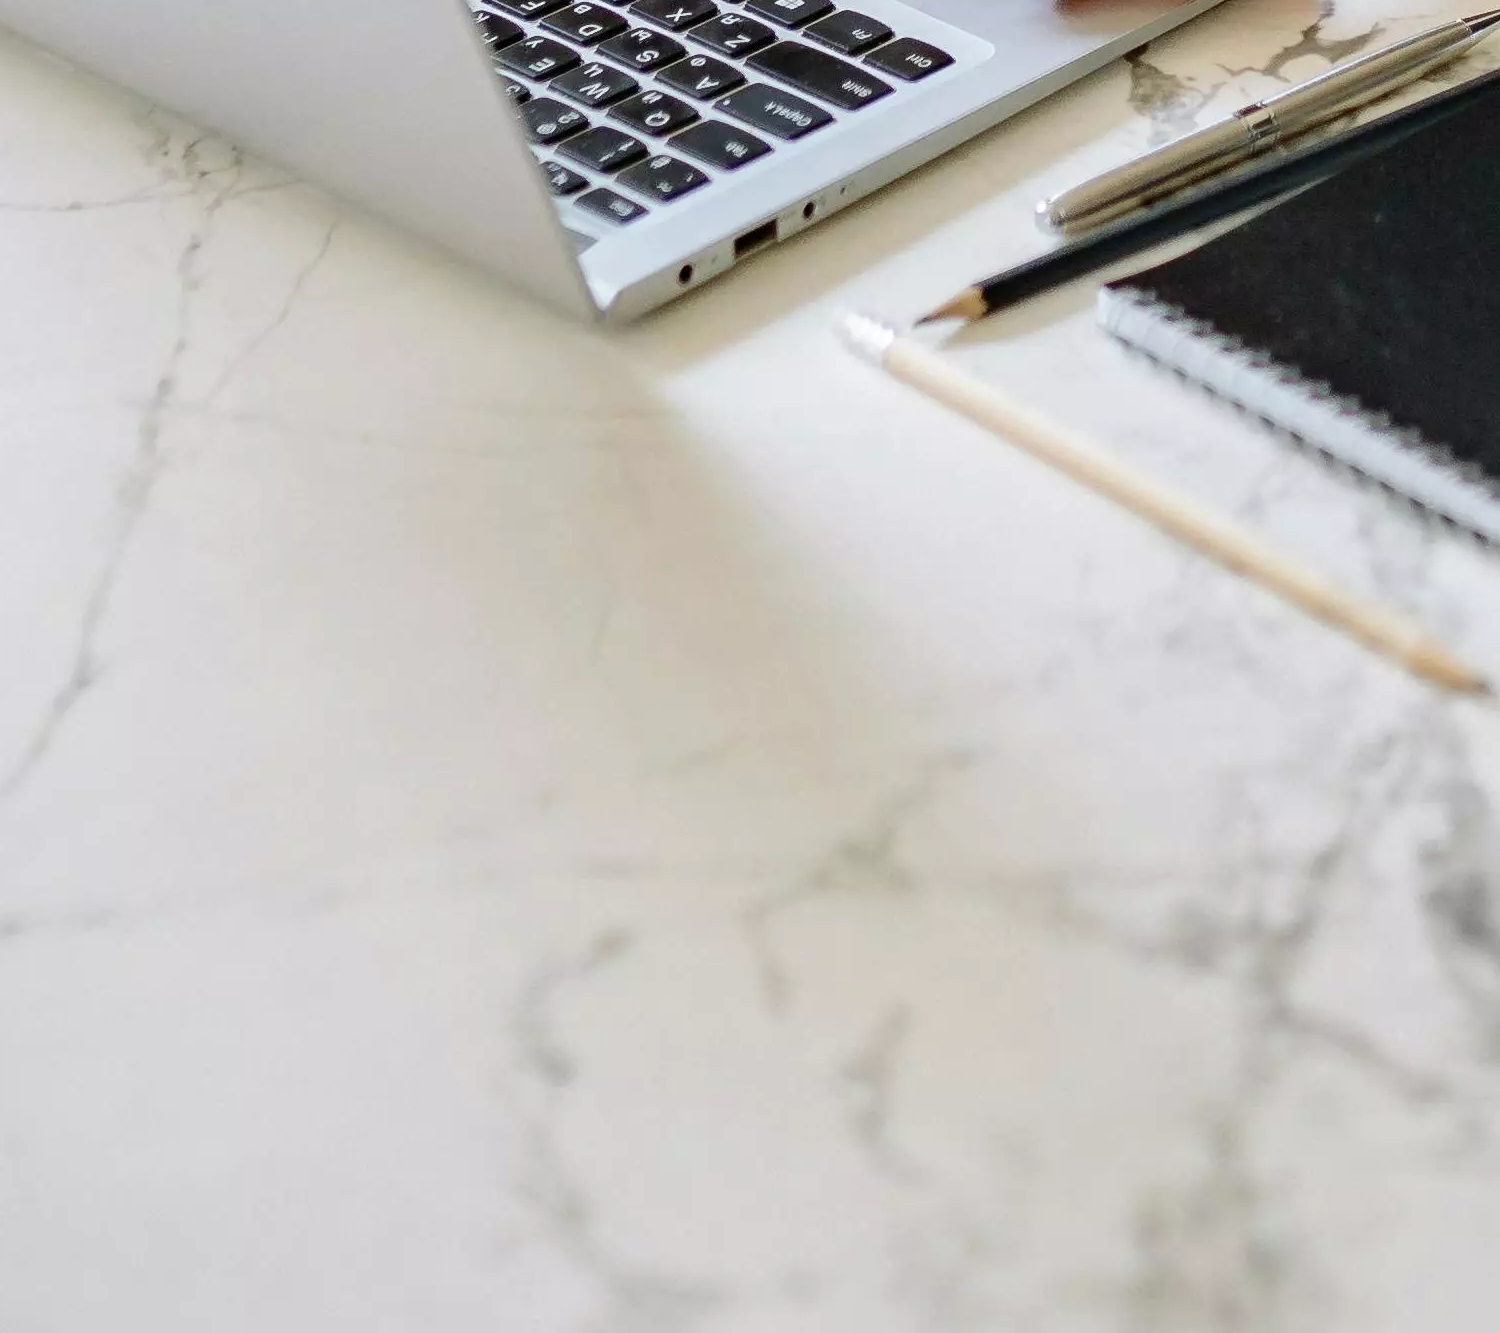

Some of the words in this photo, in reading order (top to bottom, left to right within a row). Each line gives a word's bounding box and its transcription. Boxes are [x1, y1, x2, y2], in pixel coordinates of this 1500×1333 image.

[520, 0, 546, 12] F
[665, 8, 693, 22] X
[578, 24, 604, 37] D
[850, 27, 873, 40] Fn
[723, 35, 752, 49] Z
[636, 50, 660, 63] S
[904, 52, 933, 69] Ctrl
[528, 58, 556, 73] E
[696, 76, 720, 90] A
[841, 79, 873, 98] Shift
[579, 82, 612, 100] W
[644, 109, 671, 127] Q
